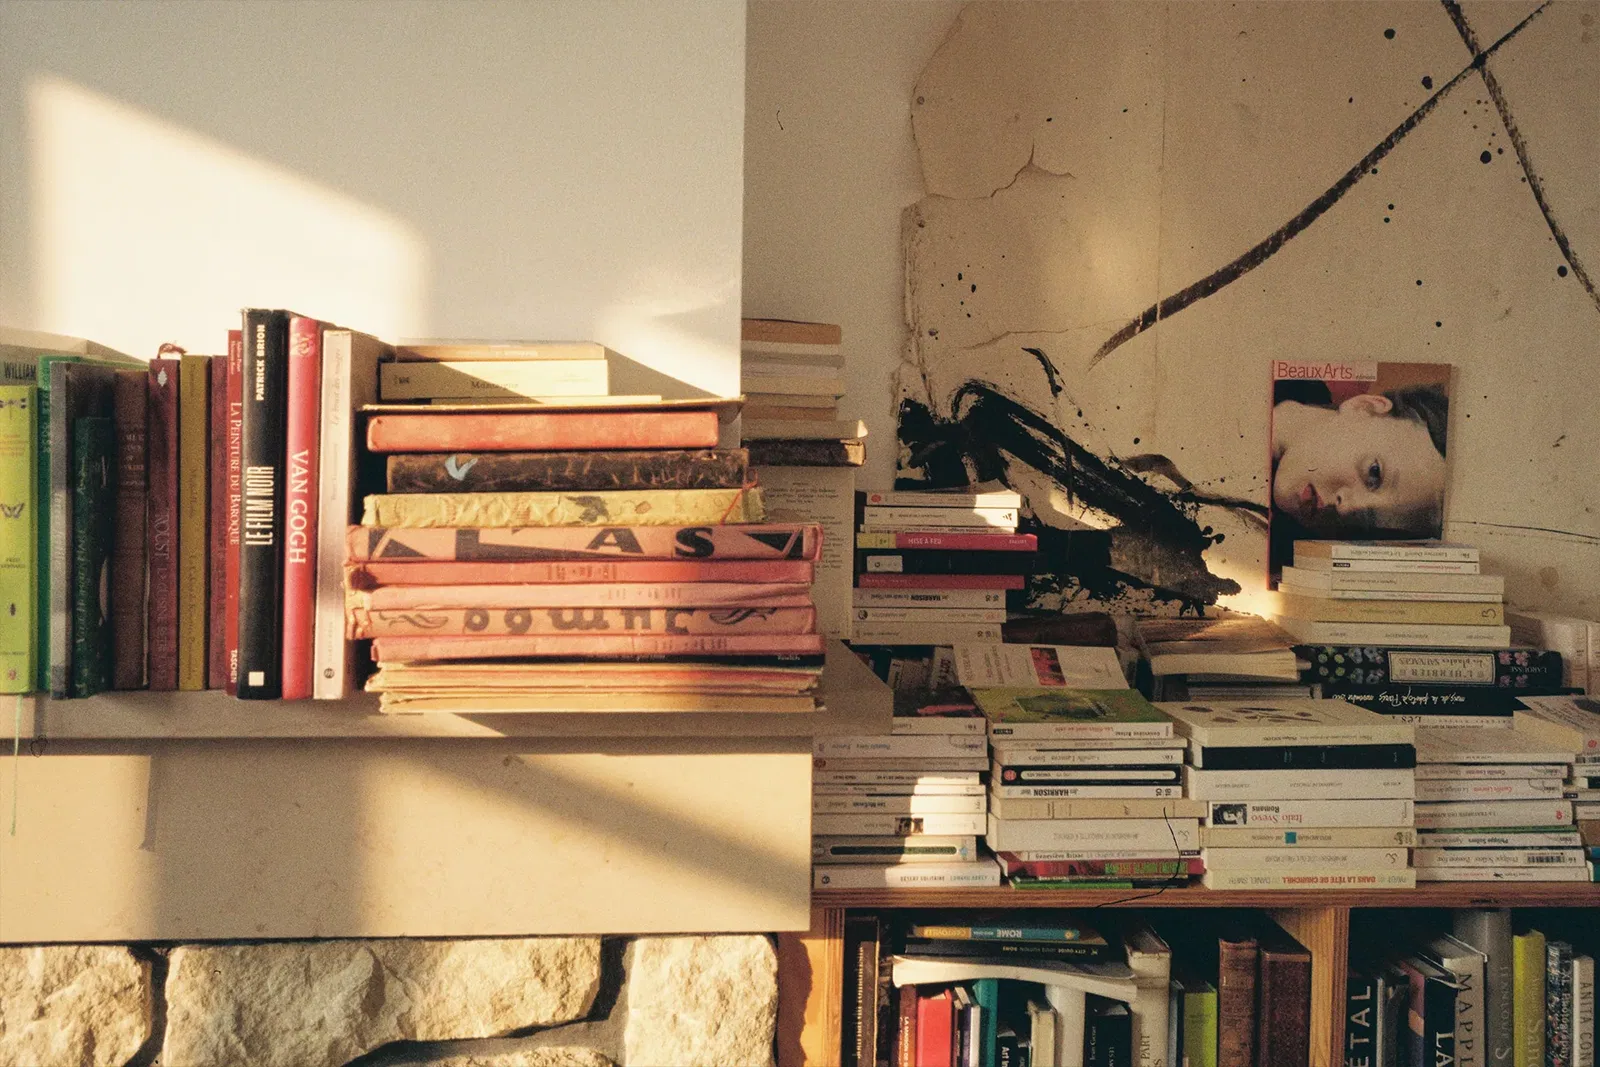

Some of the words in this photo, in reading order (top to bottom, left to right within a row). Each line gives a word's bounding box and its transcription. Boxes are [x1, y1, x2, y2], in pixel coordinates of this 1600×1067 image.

[256, 324, 266, 357] BRION
[4, 361, 37, 380] WILLIAM
[255, 360, 265, 401] PATRICK
[229, 402, 242, 416] LA
[229, 419, 242, 472] PEINTURE
[291, 449, 309, 494] VAN
[230, 475, 240, 491] DU
[245, 466, 275, 497] NOIR
[227, 494, 241, 545] BAROQUE
[245, 499, 274, 529] FILM
[245, 531, 274, 546] LE
[289, 499, 308, 564] GOGH
[910, 594, 941, 602] HARRISON
[230, 649, 238, 684] TASCHEN
[1398, 658, 1441, 666] SAUVAGES
[1441, 658, 1470, 669] plantes
[1411, 668, 1473, 679] L'HERBIER
[1378, 691, 1402, 707] Paris
[1033, 788, 1069, 796] HARRISON
[1251, 805, 1280, 814] Romans
[1250, 814, 1278, 824] Svevo
[1282, 814, 1303, 824] Italo
[1281, 876, 1319, 884] CHURCHILL
[1319, 876, 1329, 884] DE
[1329, 876, 1346, 885] TÊTE
[1346, 876, 1356, 884] LA
[1357, 876, 1377, 884] DANS
[996, 929, 1023, 939] ROME
[1561, 969, 1571, 986] XL
[1579, 982, 1592, 1024] ANITA
[904, 1016, 910, 1026] LA
[1344, 985, 1371, 1067] ÉTAL
[1558, 993, 1571, 1060] Photography
[1002, 1046, 1010, 1059] Art
[1139, 1034, 1151, 1060] PART
